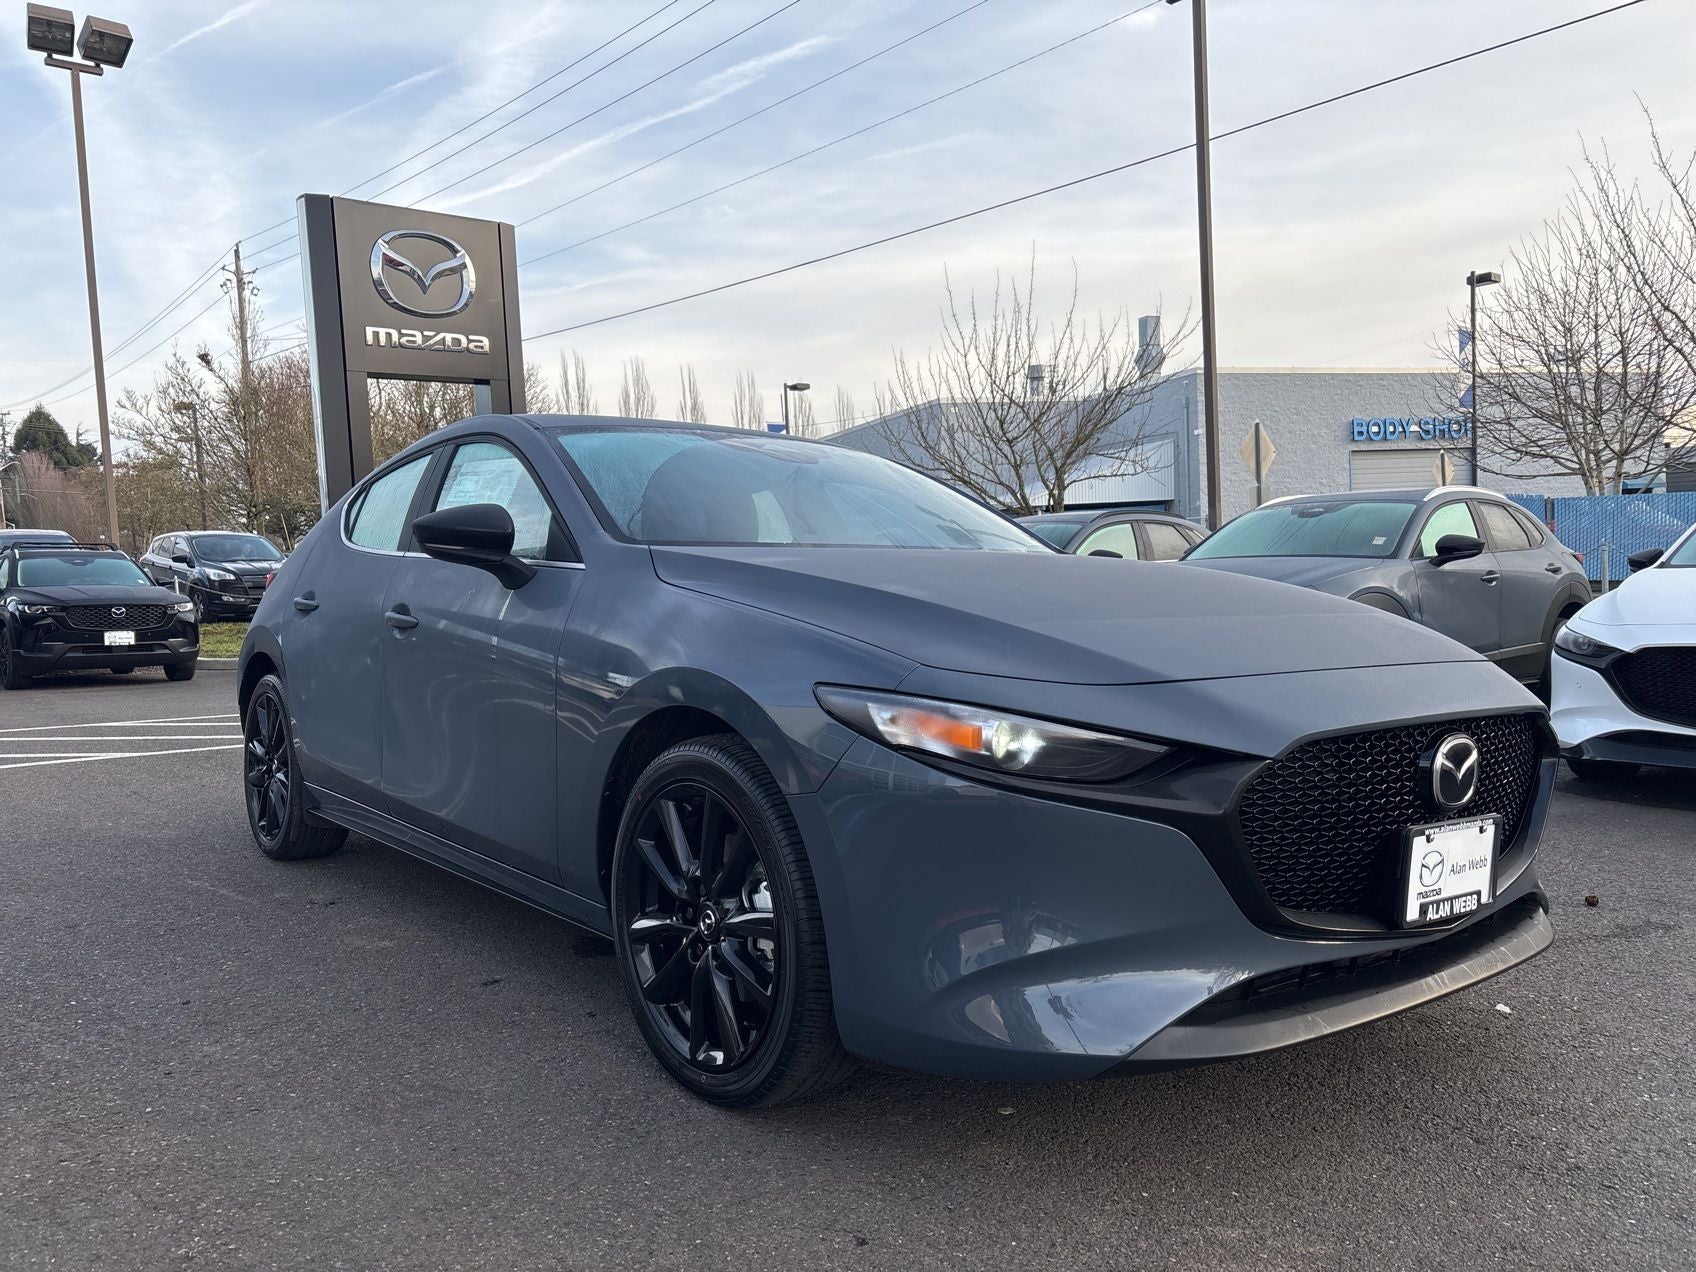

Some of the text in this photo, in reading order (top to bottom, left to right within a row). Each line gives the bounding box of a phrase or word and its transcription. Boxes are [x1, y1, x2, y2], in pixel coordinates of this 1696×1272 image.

[365, 326, 490, 354] mazda
[1352, 416, 1414, 441] BODY
[1449, 855, 1488, 876] Alan Webb
[1426, 894, 1477, 921] ALAN WEBB
